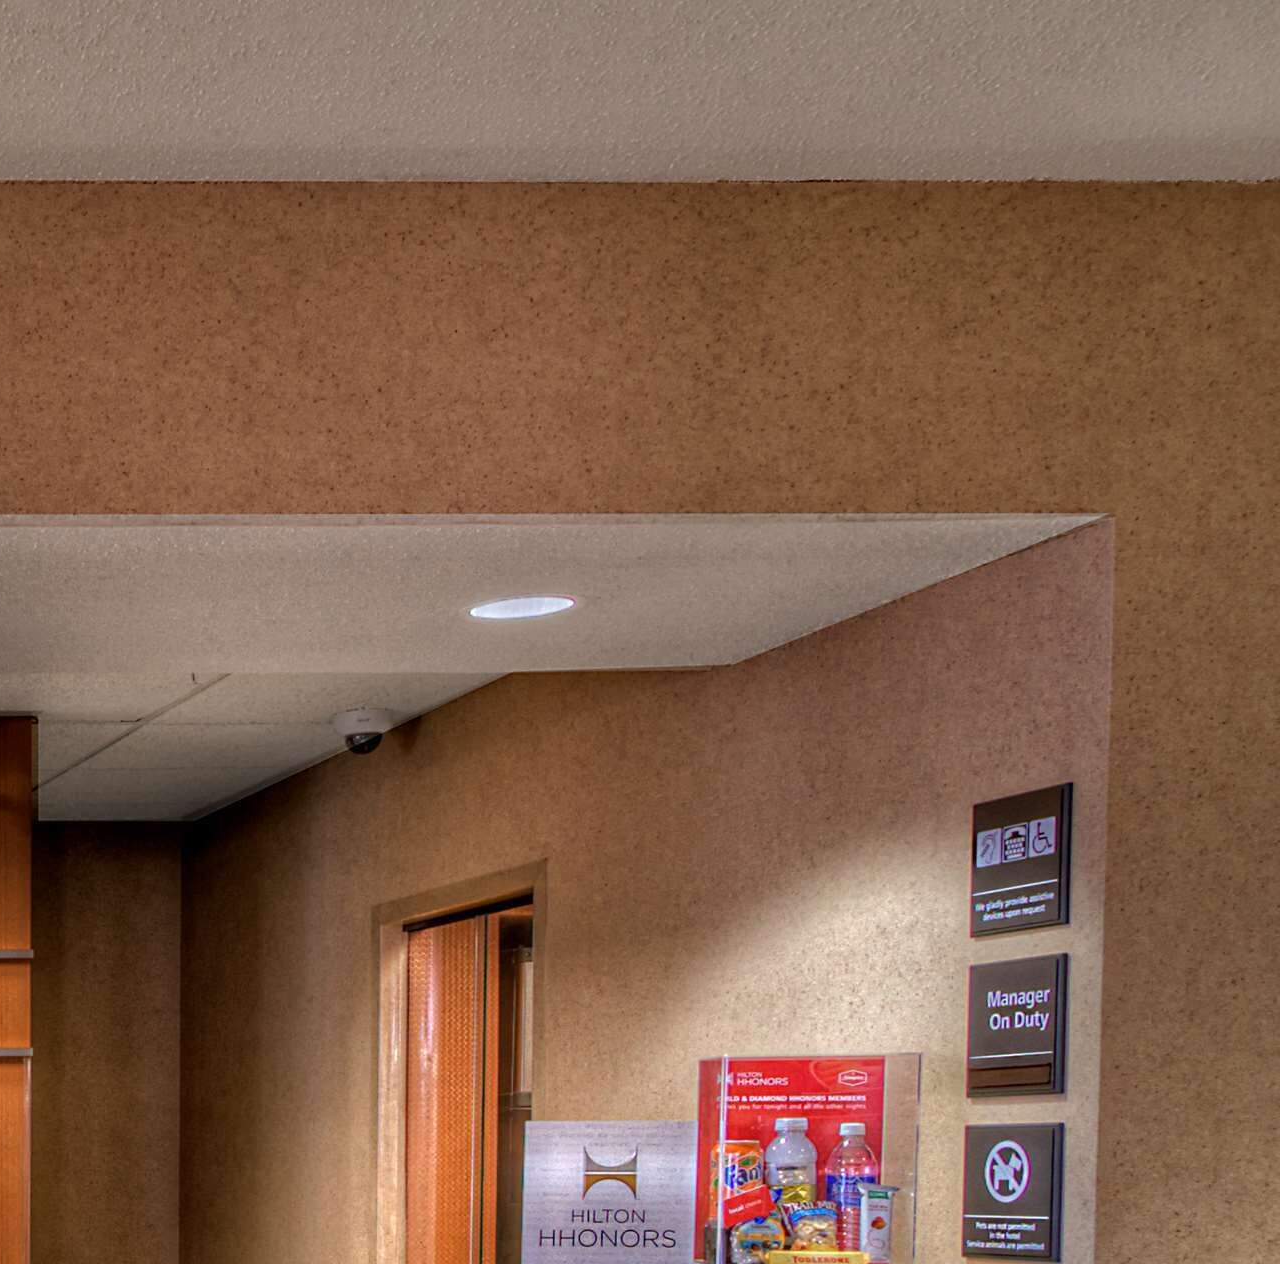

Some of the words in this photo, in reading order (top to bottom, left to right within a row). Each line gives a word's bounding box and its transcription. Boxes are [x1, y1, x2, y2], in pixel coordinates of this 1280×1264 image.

[987, 988, 1051, 1008] Manager
[989, 1012, 1010, 1030] On
[1014, 1010, 1050, 1031] Duty
[736, 1077, 790, 1086] HHONORS
[571, 1208, 646, 1223] HILTON
[539, 1228, 677, 1248] HHONORS
